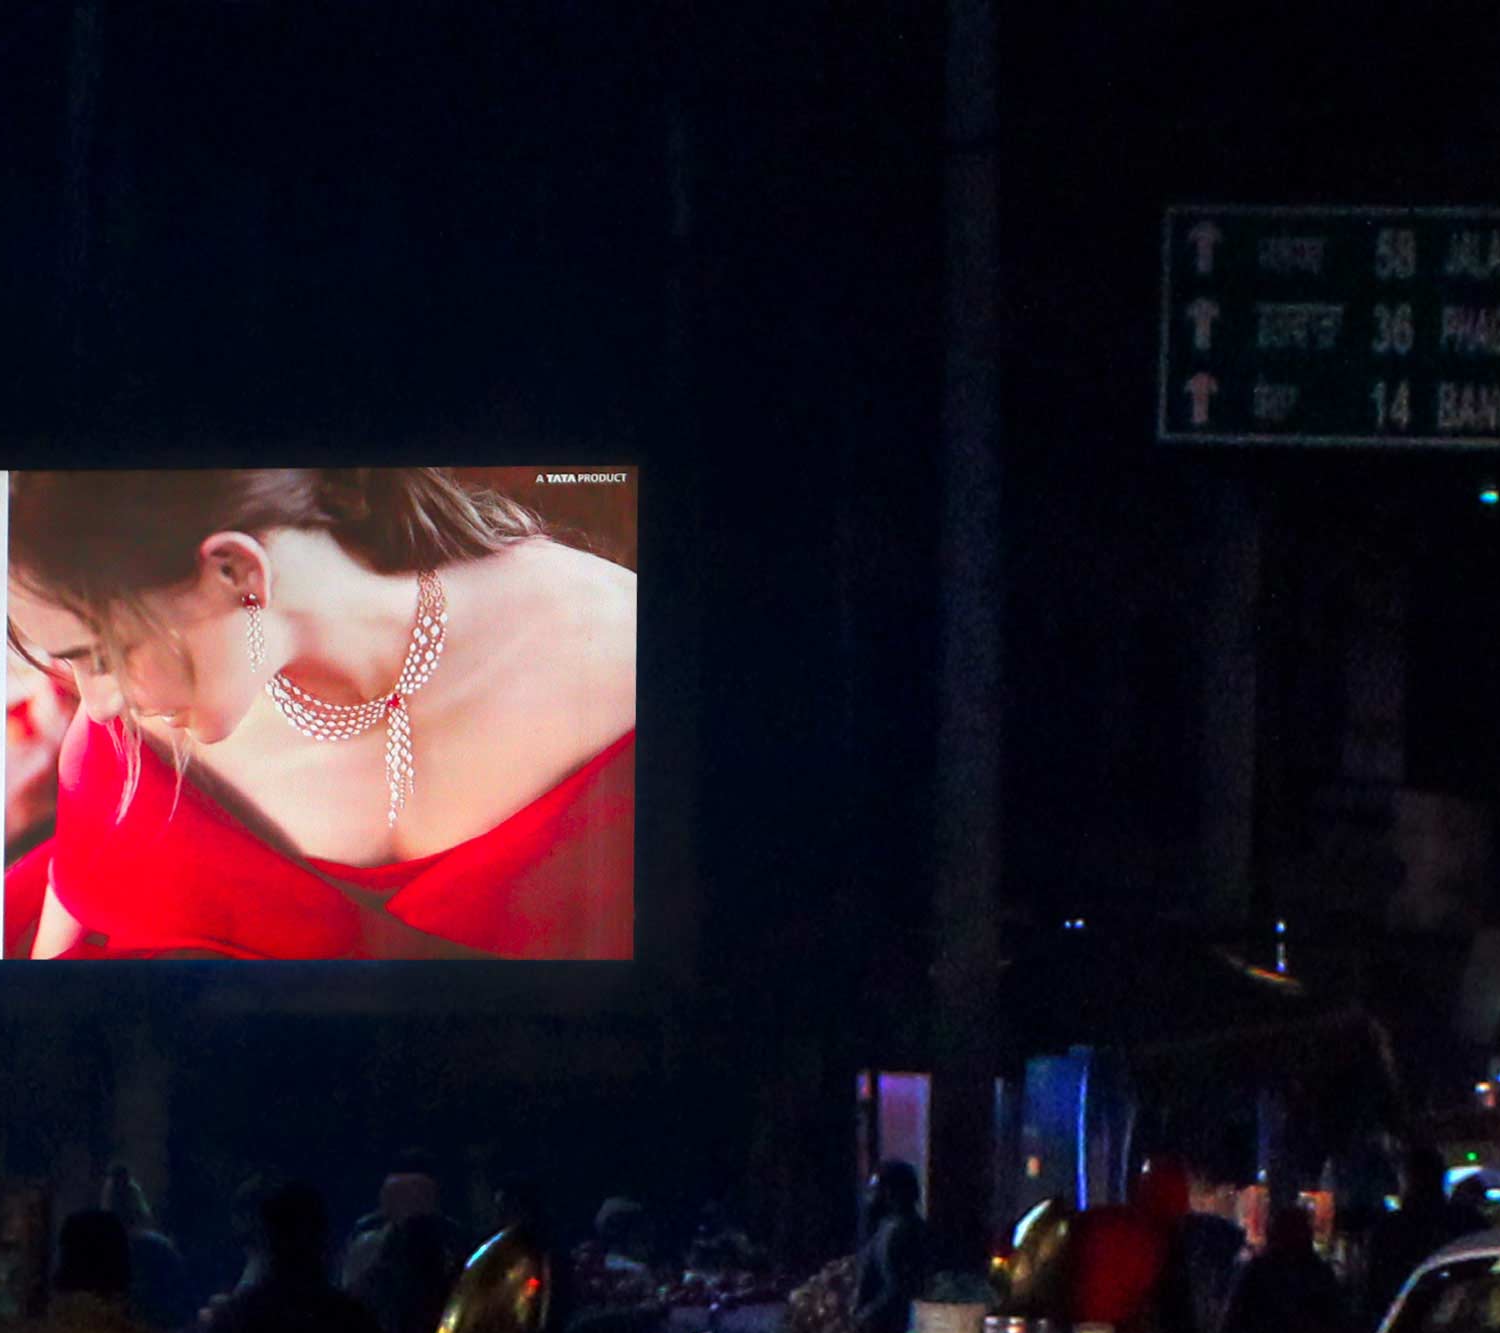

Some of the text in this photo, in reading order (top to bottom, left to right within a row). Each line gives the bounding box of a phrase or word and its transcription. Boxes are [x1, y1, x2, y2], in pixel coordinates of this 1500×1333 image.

[1369, 380, 1411, 429] 14
[535, 473, 628, 484] A TATA PRODUCT
